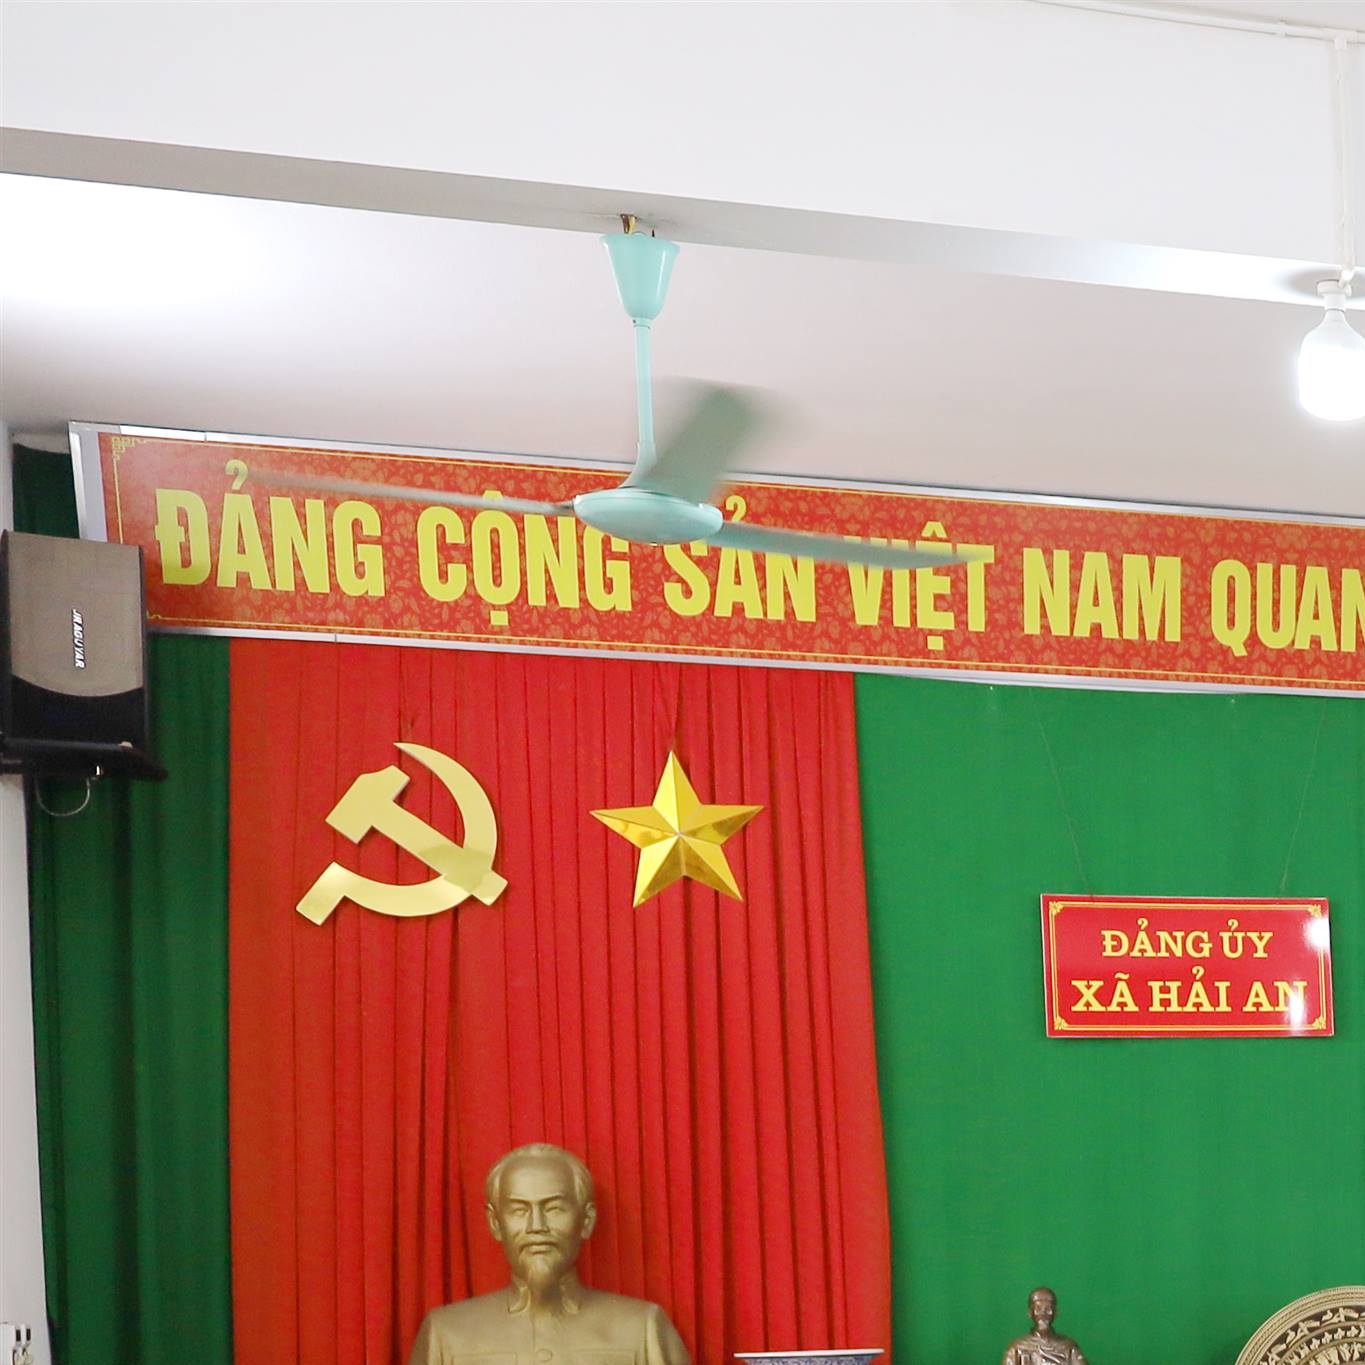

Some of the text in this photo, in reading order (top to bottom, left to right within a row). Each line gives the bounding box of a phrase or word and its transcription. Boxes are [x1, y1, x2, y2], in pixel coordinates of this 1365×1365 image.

[155, 459, 385, 597] ĐẢNG
[418, 489, 632, 626] CỘNG
[663, 495, 816, 622] SẢN
[844, 521, 994, 650] VIỆT
[1023, 547, 1181, 642] NAM
[1101, 918, 1273, 958] ĐẢNG ỦY
[1071, 965, 1308, 1013] XÃ HẢI AN
